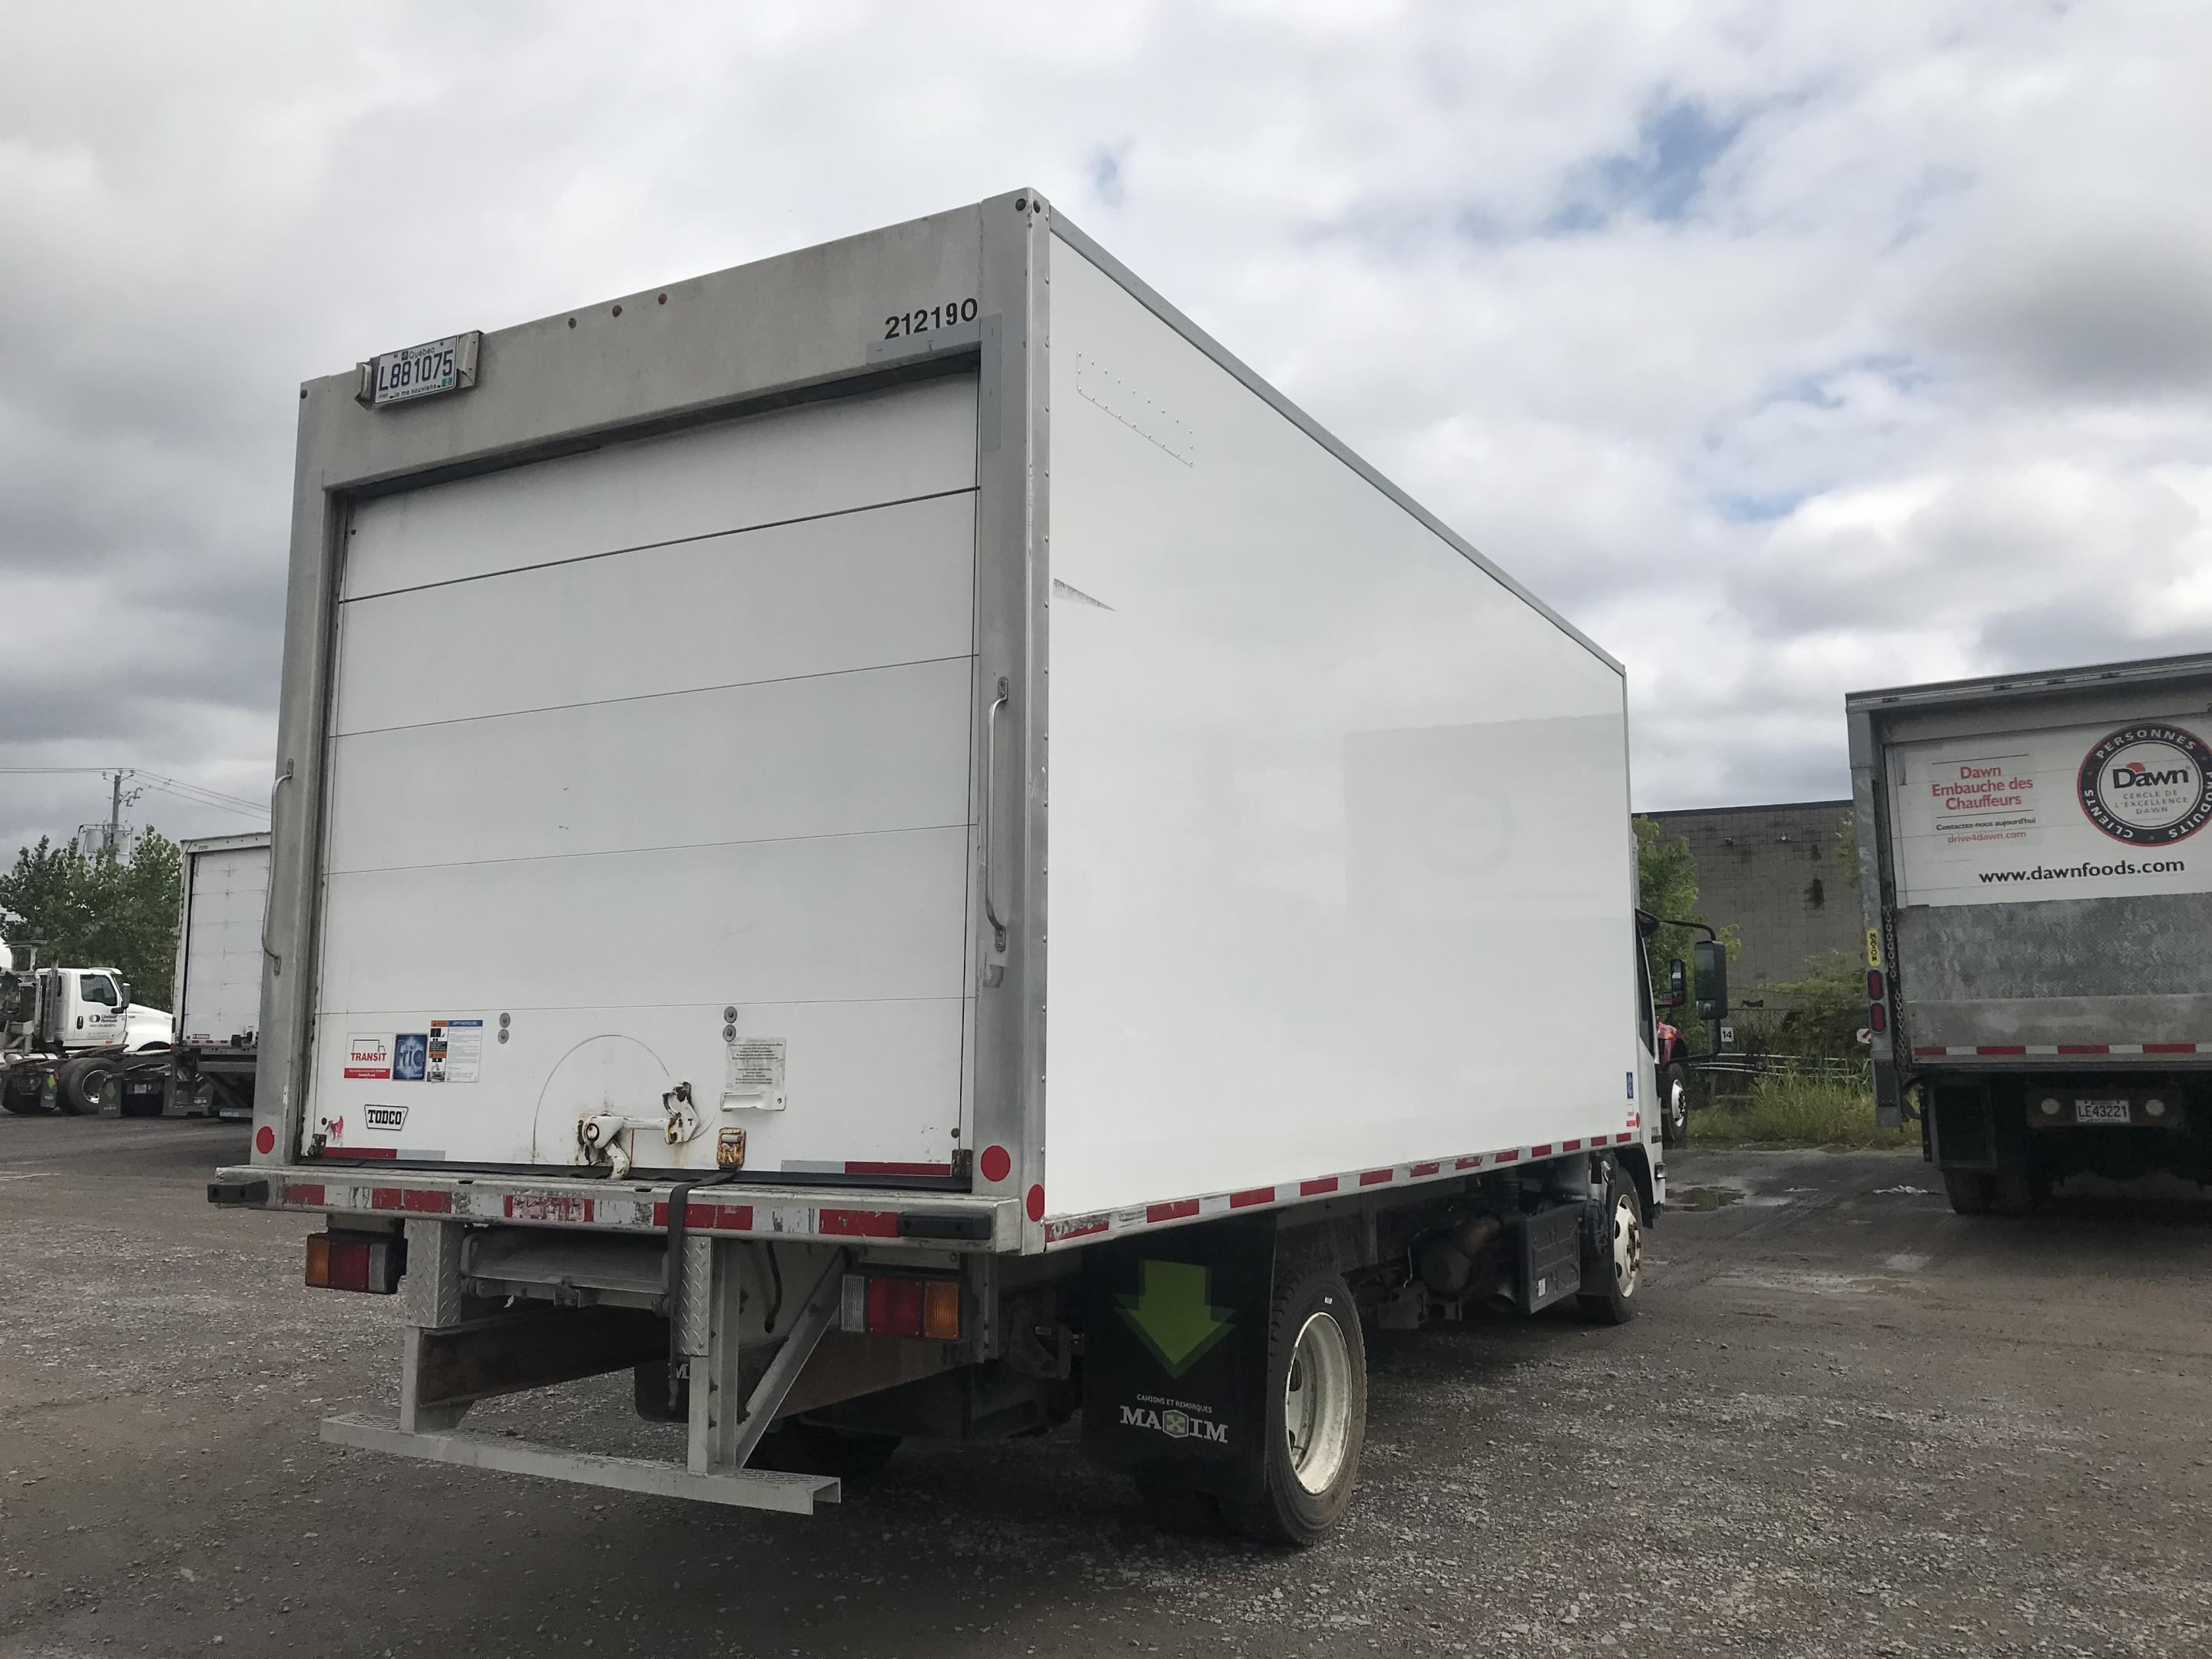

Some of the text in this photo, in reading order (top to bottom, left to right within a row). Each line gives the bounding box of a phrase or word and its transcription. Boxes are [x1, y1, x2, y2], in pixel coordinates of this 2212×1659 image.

[884, 297, 978, 340] 212190
[379, 349, 453, 391] L881075
[2096, 729, 2197, 759] PERSONNES
[1960, 767, 2002, 780] Dawn
[2112, 768, 2189, 789] Dawn
[1932, 777, 2034, 796] Embauche des
[1945, 795, 2022, 810] Chauffeurs
[2115, 796, 2188, 808] L'EXCELLENCE
[2084, 789, 2134, 839] CLIENTS
[2136, 806, 2168, 815] DAWN
[1936, 821, 1994, 831] Contactez-nous
[1948, 830, 2027, 843] drive4dawn.com
[1979, 859, 2185, 883] www.dawnfoods.com
[1722, 1029, 1732, 1039] 14
[351, 1052, 387, 1061] TRANSIT
[368, 1109, 402, 1125] TODCO
[2078, 1105, 2127, 1118] LE43221
[1137, 1394, 1165, 1405] CAMIONS
[1175, 1400, 1213, 1414] REMORQUES
